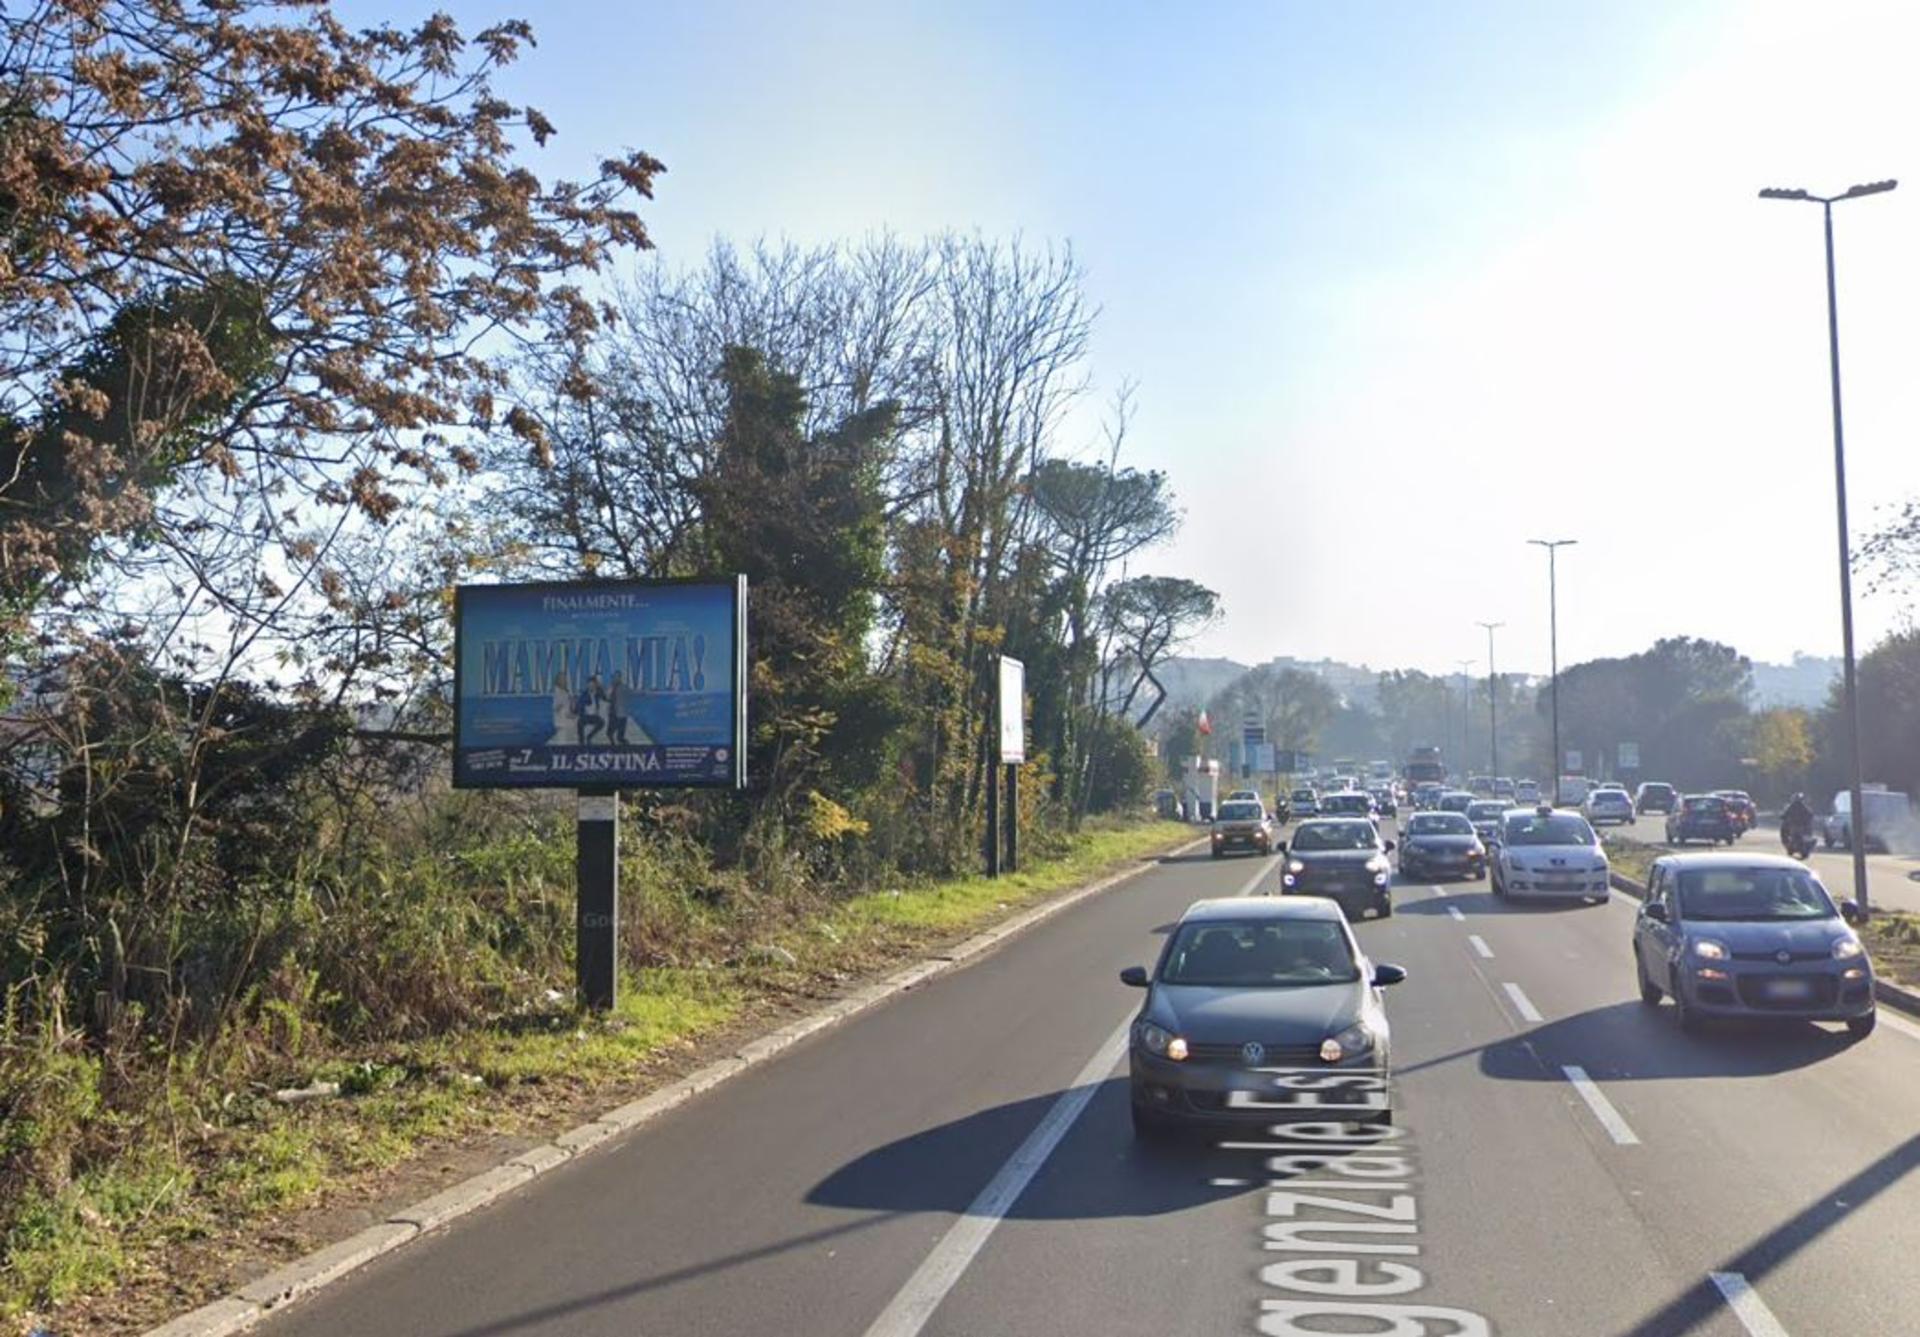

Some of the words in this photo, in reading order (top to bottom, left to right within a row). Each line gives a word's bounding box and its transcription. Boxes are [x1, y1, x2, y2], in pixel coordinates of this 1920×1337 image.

[482, 636, 614, 698] MAMMA
[625, 634, 706, 694] MIA!
[551, 754, 572, 769] IL
[572, 752, 661, 772] SISTINA
